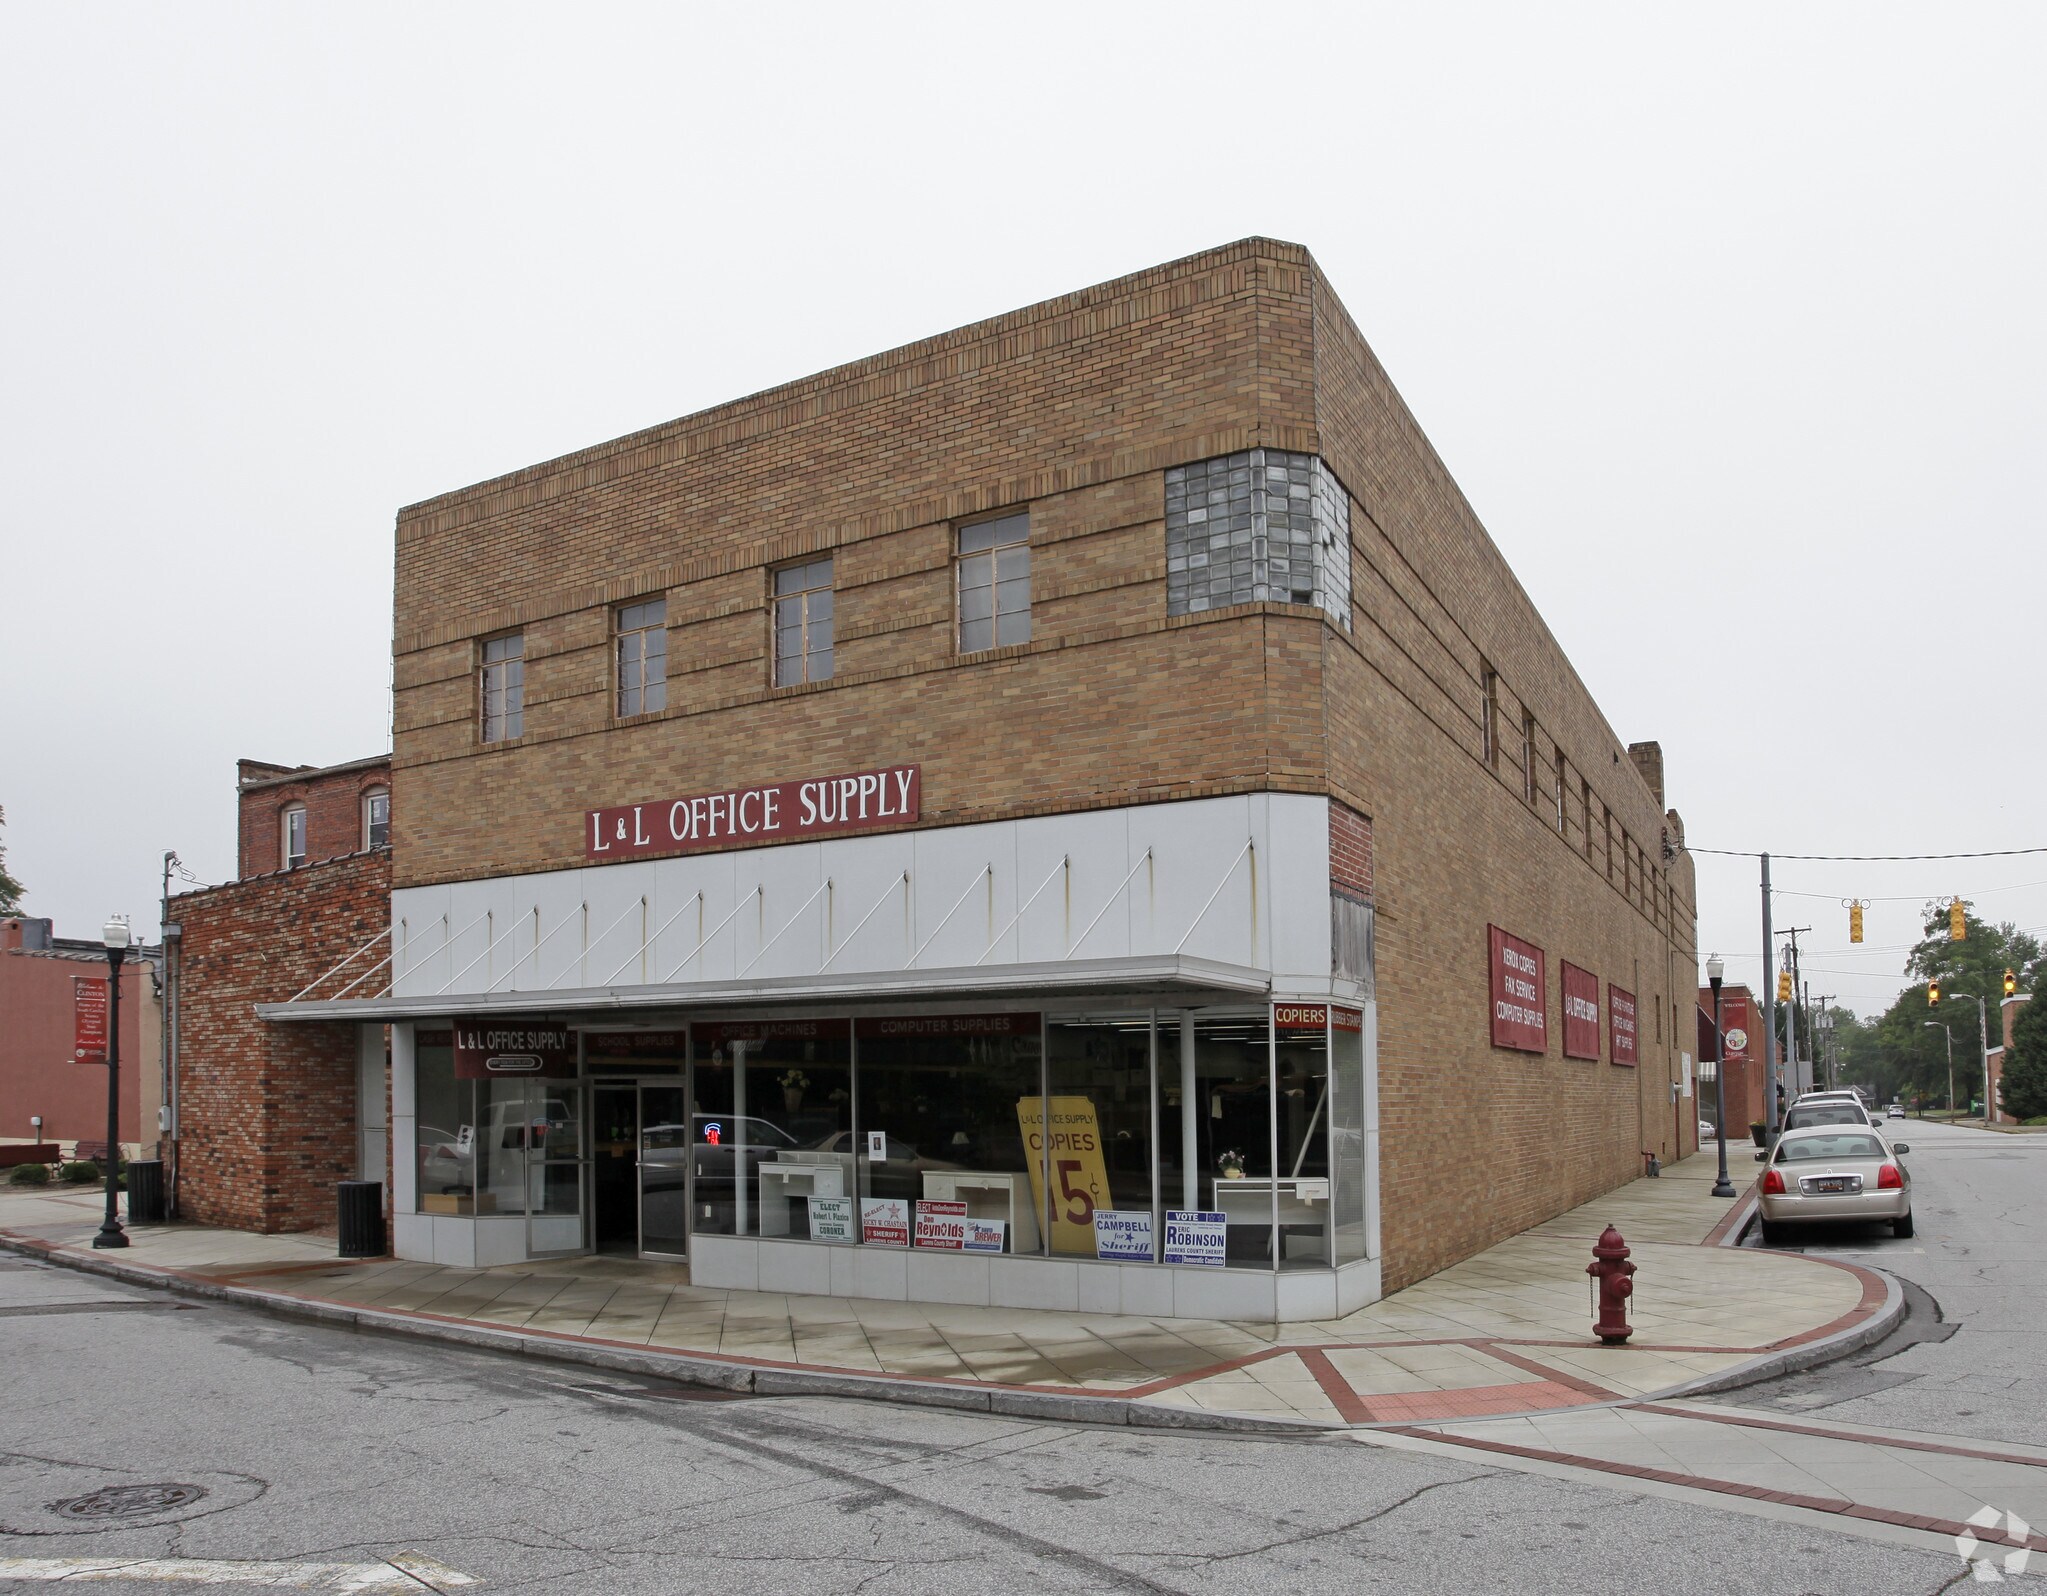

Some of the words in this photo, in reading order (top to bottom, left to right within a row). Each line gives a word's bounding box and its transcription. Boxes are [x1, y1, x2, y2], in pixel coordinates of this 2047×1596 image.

[593, 812, 610, 851] L
[616, 817, 627, 840] &
[633, 807, 650, 846] L
[669, 788, 780, 841] OFFICE
[799, 769, 914, 827] SUPPLY
[1502, 946, 1519, 969] XEROX
[1519, 955, 1536, 976] COPIES
[1505, 975, 1515, 996] FAX
[1516, 979, 1536, 1001] SERVICE
[1275, 1008, 1325, 1023] COPIERS
[1496, 1000, 1523, 1024] COMPUTER
[1524, 1008, 1543, 1029] SUPPLIES
[1574, 996, 1586, 1020] OFFICE
[1586, 1001, 1597, 1023] SUPPLY
[881, 1020, 948, 1034] COMPUTER
[953, 1017, 1010, 1032] SUPPLIES
[1332, 1010, 1346, 1026] RUBBER
[1346, 1013, 1362, 1028] STAMPS
[721, 1024, 756, 1037] OFFICE
[760, 1023, 817, 1036] MACHINES
[458, 1030, 466, 1049] L
[468, 1032, 475, 1049] &
[478, 1031, 484, 1049] L
[486, 1030, 524, 1050] OFFICE
[527, 1030, 566, 1050] SUPPLY
[598, 1036, 631, 1047] SCHOOL
[634, 1035, 675, 1046] SUPPLIES
[1065, 1114, 1094, 1124] SUPPLY
[1028, 1132, 1095, 1151] COPIES
[820, 1203, 840, 1212] ELECT
[864, 1204, 885, 1218] RE-ELECT
[917, 1203, 931, 1213] ELECT
[813, 1212, 827, 1220] Robert
[864, 1218, 877, 1226] RICKY
[924, 1215, 934, 1223] Don
[1175, 1213, 1198, 1221] VOTE
[820, 1226, 845, 1236] CORONER
[1096, 1220, 1150, 1232] CAMPBELL
[872, 1230, 898, 1238] SHERIFF
[974, 1232, 1002, 1242] BREWER
[1114, 1232, 1124, 1241] for
[1166, 1226, 1224, 1248] ROBINSON
[1100, 1240, 1151, 1254] Sheriff
[1184, 1256, 1204, 1264] Democratic
